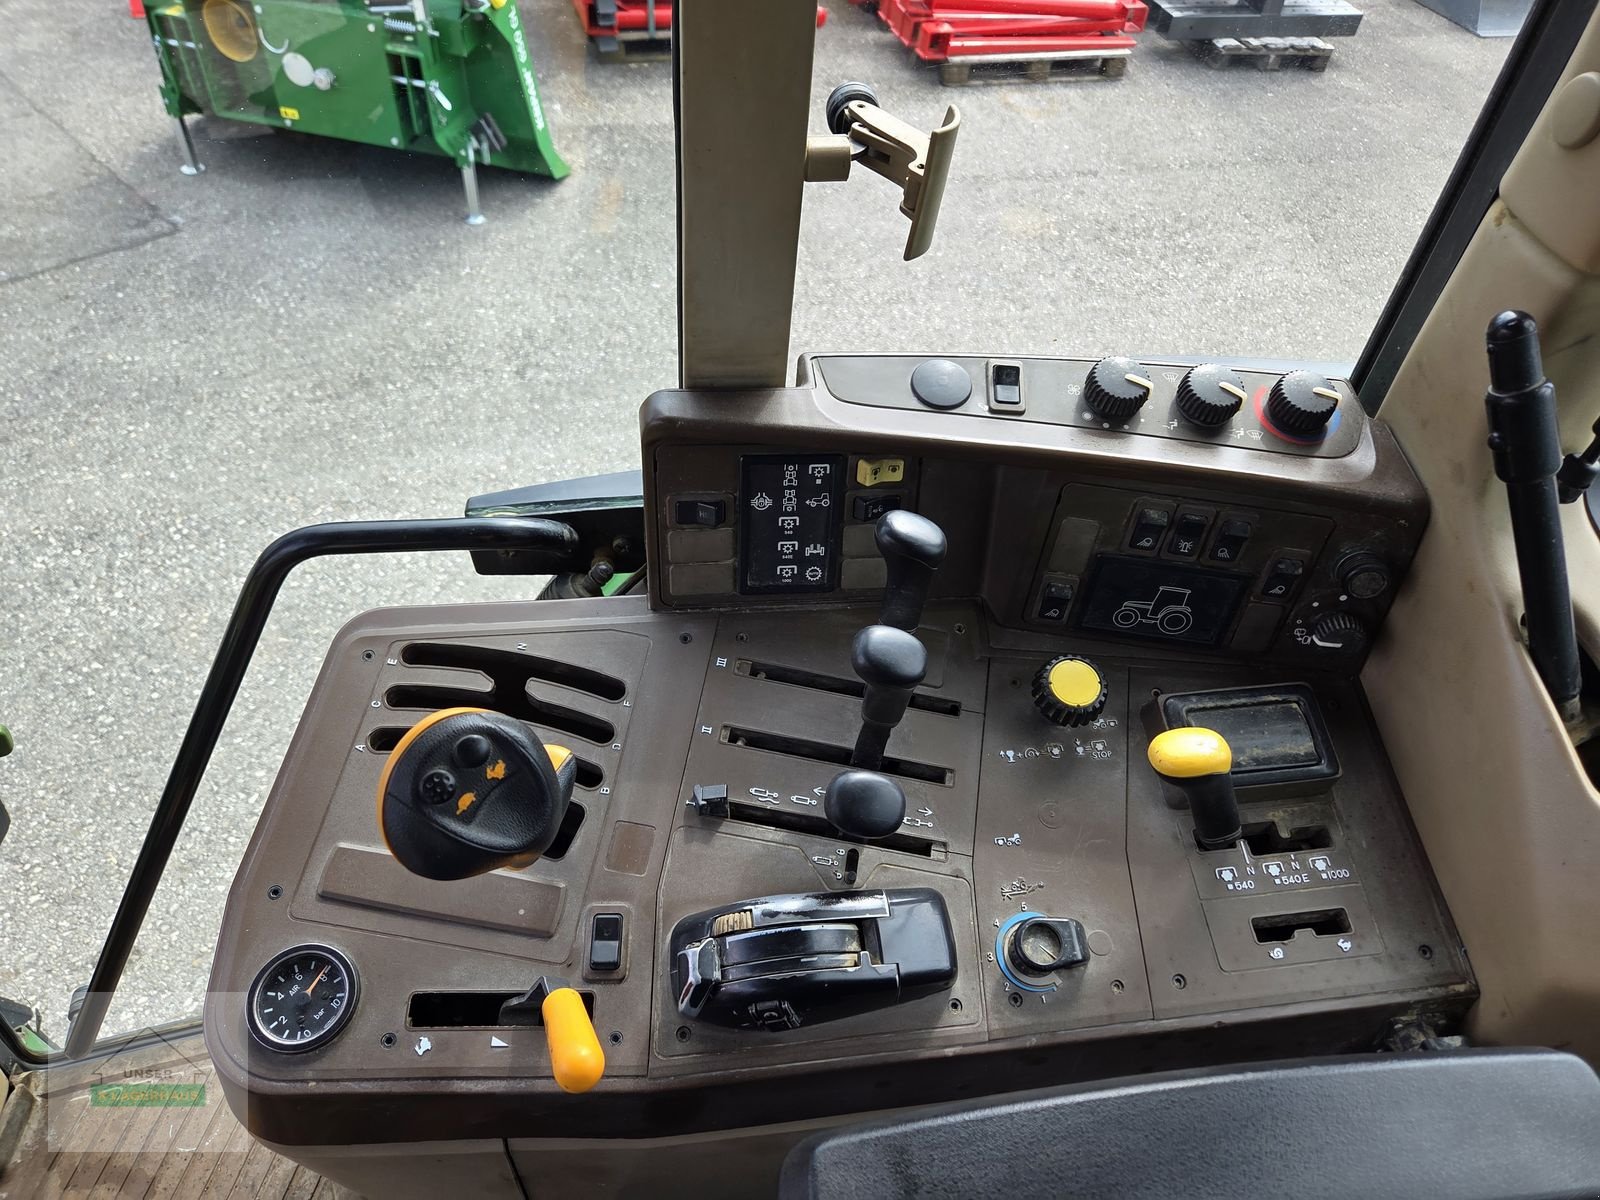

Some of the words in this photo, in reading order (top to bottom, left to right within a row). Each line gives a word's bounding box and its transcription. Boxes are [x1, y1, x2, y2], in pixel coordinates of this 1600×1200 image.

[387, 657, 398, 666] E
[623, 700, 631, 708] F
[354, 743, 366, 752] A
[1092, 750, 1112, 759] STOP
[600, 786, 610, 796] B
[1246, 866, 1255, 875] N
[1291, 861, 1300, 870] N
[1328, 869, 1350, 880] 1000
[1234, 880, 1255, 890] 540
[1021, 902, 1027, 911] 5
[993, 918, 1000, 928] 4
[987, 951, 994, 962] 3
[319, 974, 328, 982] 8
[289, 984, 300, 996] AIR
[1004, 981, 1010, 991] 2
[277, 991, 285, 1001] 4
[1041, 995, 1046, 1004] 1
[330, 998, 341, 1009] 10
[313, 1008, 325, 1020] bar
[278, 1015, 288, 1025] 2
[303, 1029, 312, 1038] 0
